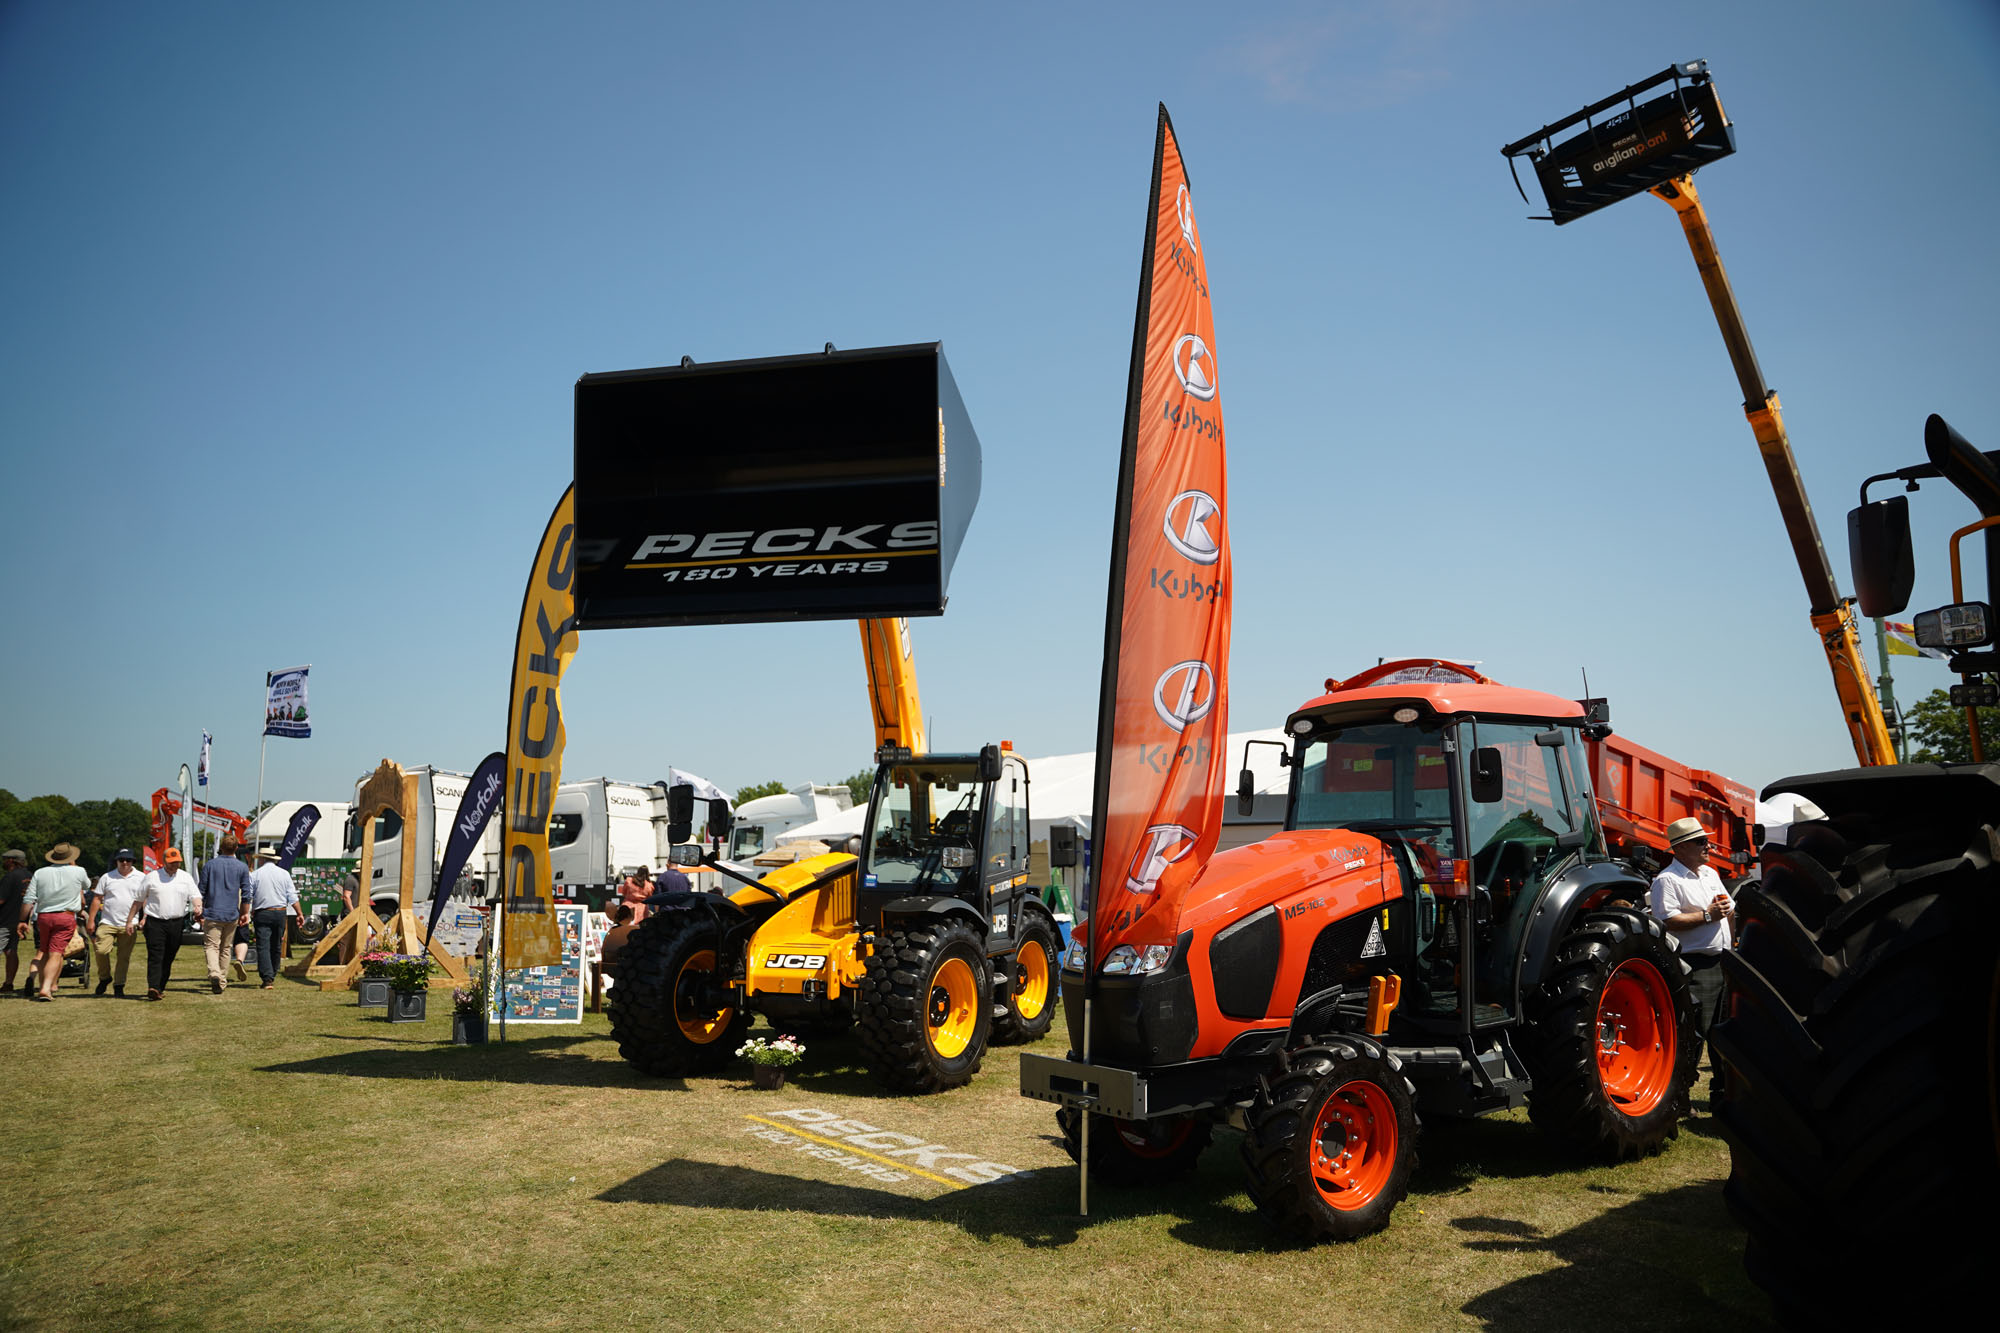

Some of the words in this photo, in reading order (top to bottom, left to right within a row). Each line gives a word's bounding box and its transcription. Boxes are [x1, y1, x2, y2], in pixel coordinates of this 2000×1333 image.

[1593, 131, 1668, 172] anglianpant
[631, 520, 938, 561] PECKS
[663, 567, 738, 583] 180
[749, 560, 890, 579] YEARS
[460, 772, 501, 840] Norfolk
[610, 795, 641, 807] SCANIA
[285, 815, 312, 855] Norfolk
[992, 913, 1008, 934] JCB
[766, 954, 826, 969] JCB
[764, 1108, 1035, 1185] PECKS
[797, 1143, 910, 1183] YEARS
